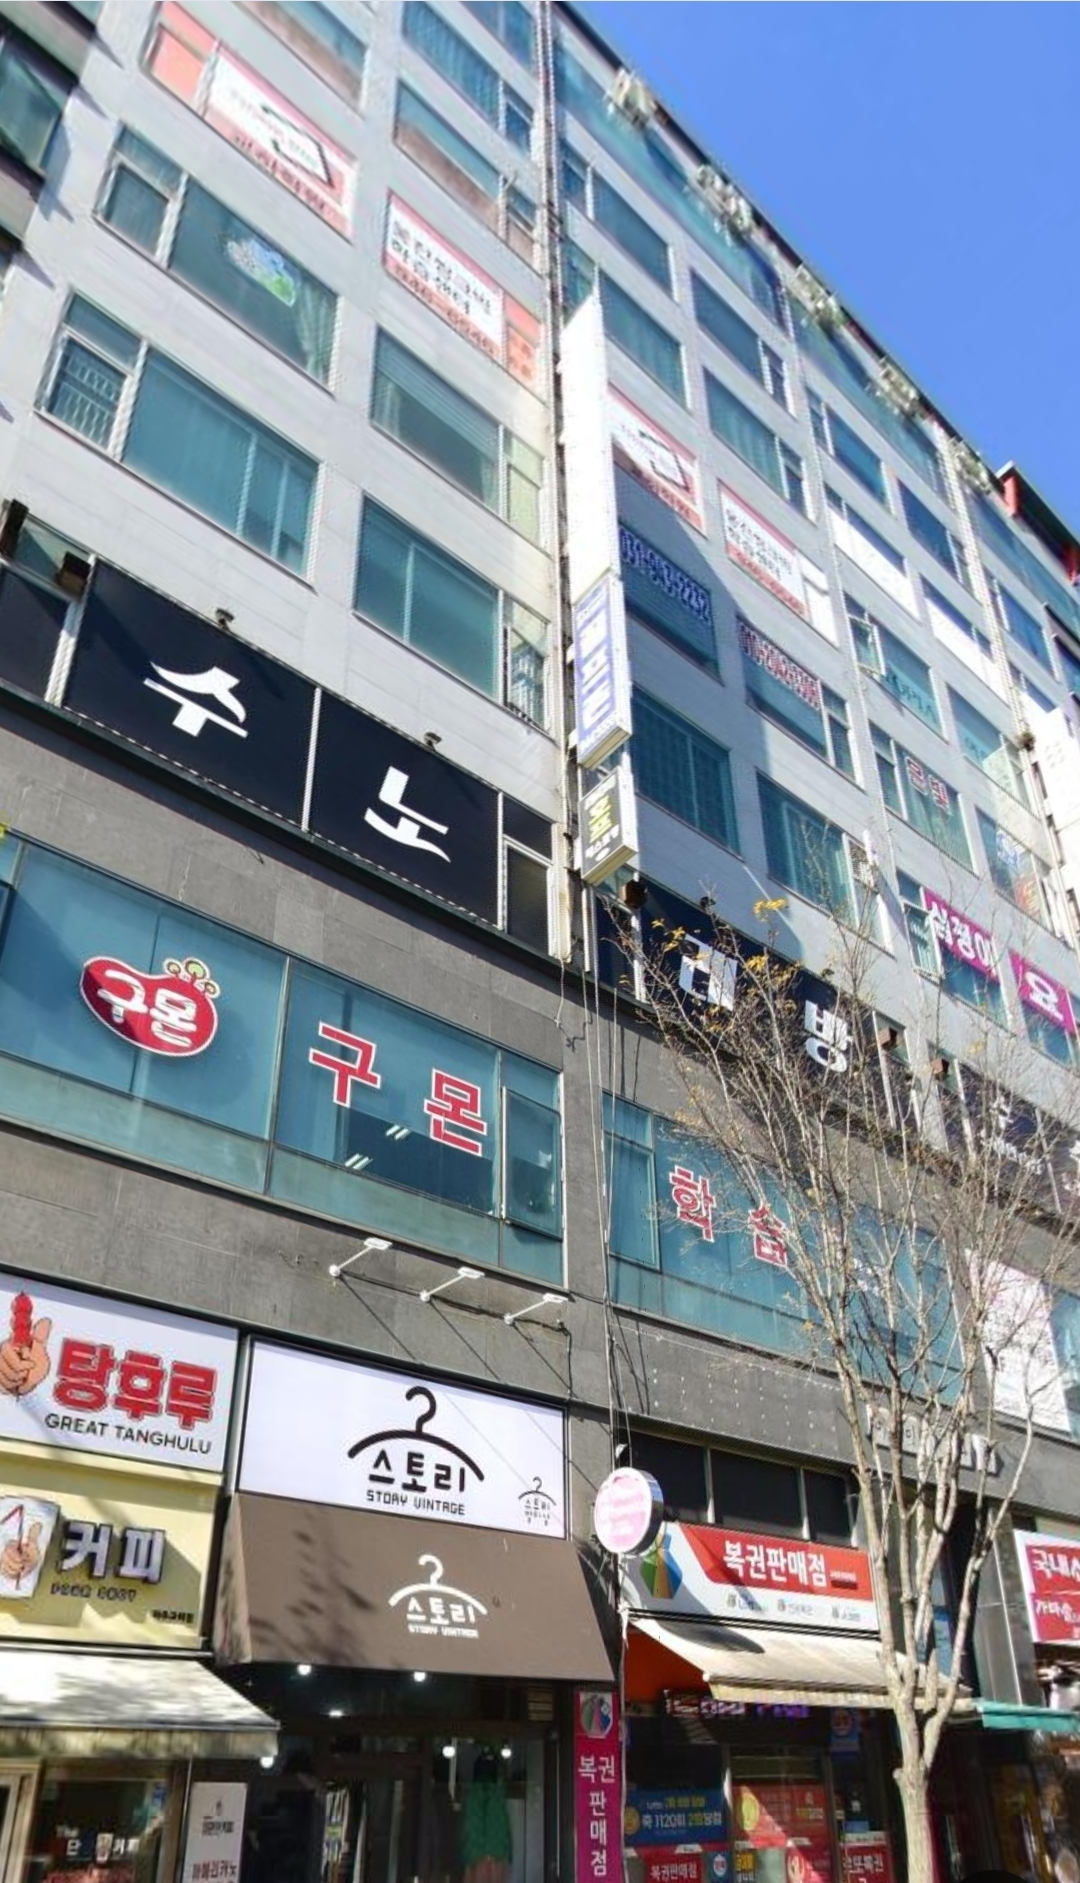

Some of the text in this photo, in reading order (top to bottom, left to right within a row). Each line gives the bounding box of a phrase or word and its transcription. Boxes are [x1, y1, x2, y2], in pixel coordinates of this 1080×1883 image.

[97, 969, 197, 1048] 구몬
[53, 1337, 218, 1431] 탕후루
[45, 1412, 212, 1455] GREAT TANGHULU
[368, 1449, 465, 1493] 스토리
[413, 1496, 466, 1516] VINTAGE
[58, 1521, 166, 1584] 커피
[723, 1539, 827, 1588] 복권판매점
[406, 1596, 476, 1624] 스토리
